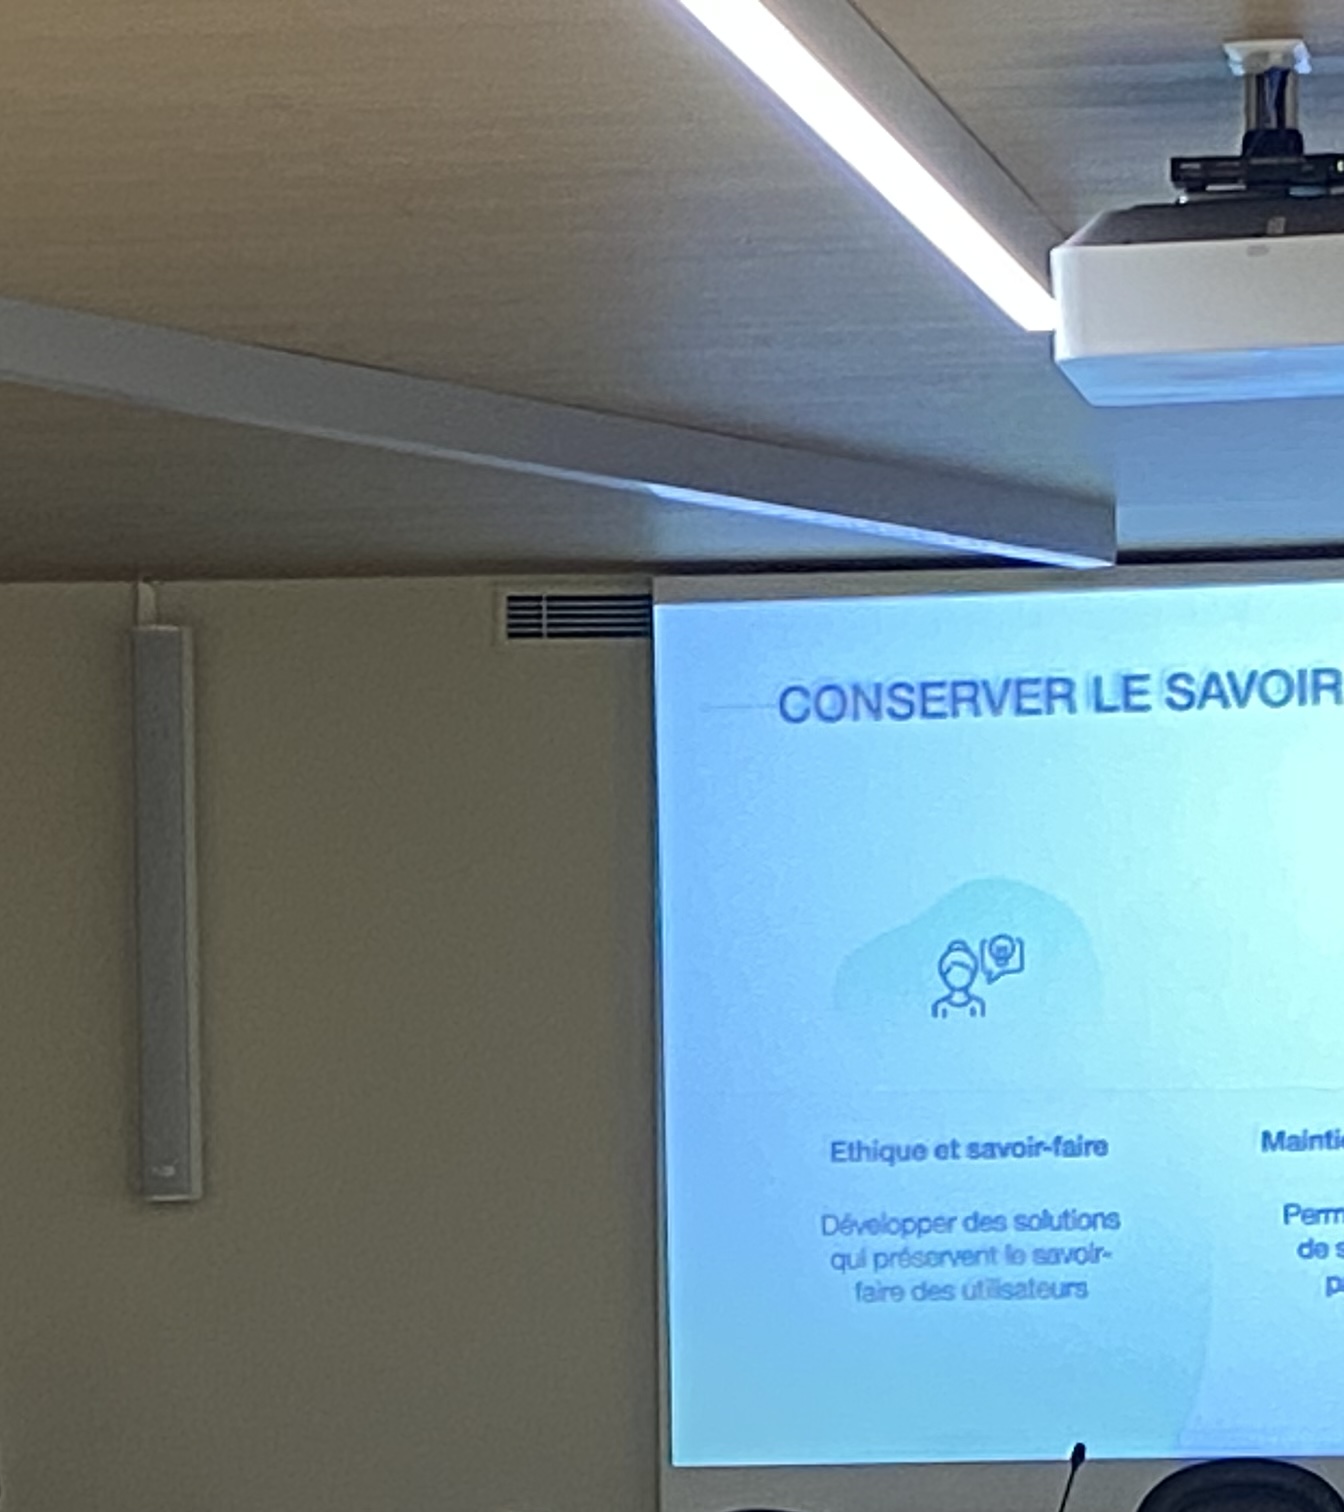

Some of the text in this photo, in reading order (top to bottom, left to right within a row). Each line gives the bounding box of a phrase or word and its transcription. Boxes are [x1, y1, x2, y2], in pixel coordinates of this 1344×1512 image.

[778, 675, 1076, 724] CONSERVER
[1092, 672, 1152, 714] LE
[830, 1134, 1109, 1167] Ethique et savoir-faire
[821, 1208, 1122, 1239] Développer des solutions
[830, 1248, 866, 1274] qui
[873, 1244, 997, 1273] préservent
[1005, 1243, 1025, 1266] le
[1297, 1237, 1329, 1260] de
[855, 1277, 1089, 1303] faire des utilisateurs
